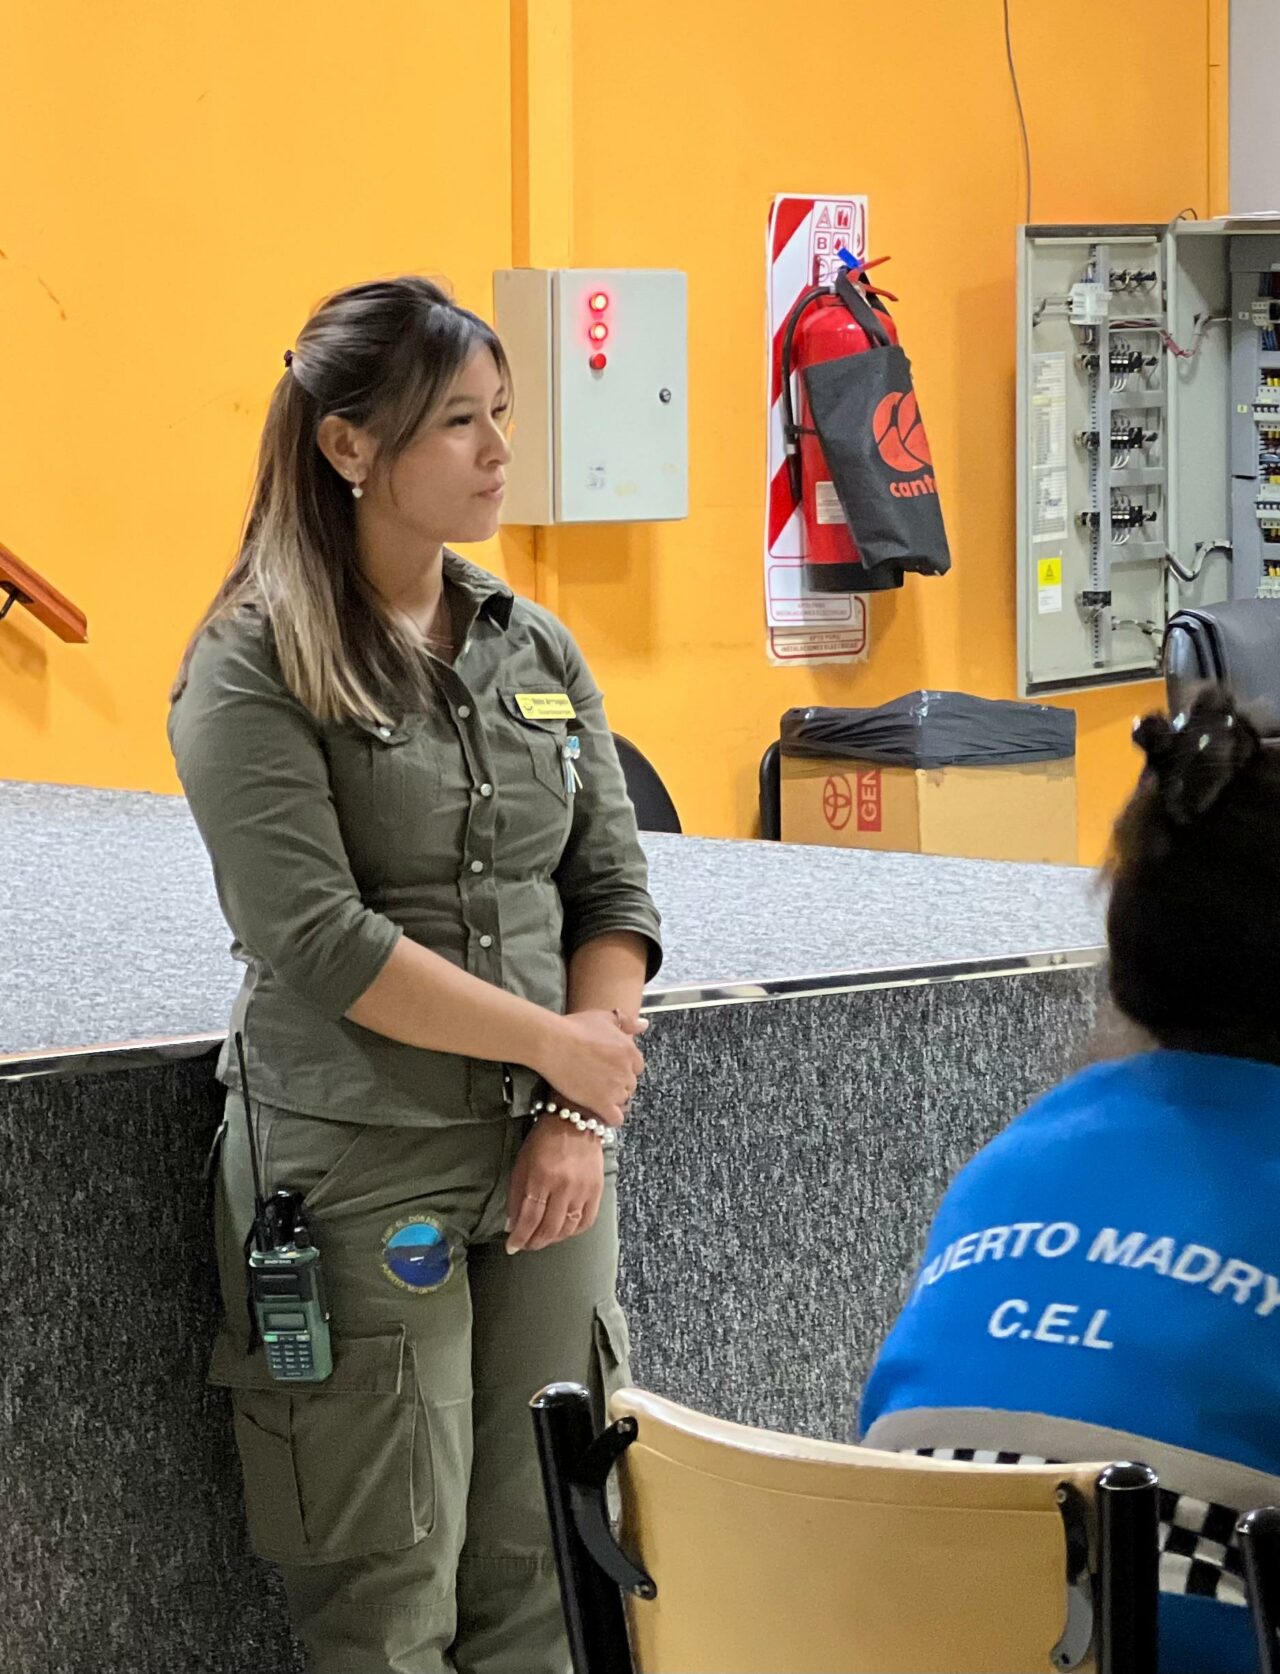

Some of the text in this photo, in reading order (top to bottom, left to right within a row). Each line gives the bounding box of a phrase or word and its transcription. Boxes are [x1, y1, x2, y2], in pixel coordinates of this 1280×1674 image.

[817, 237, 828, 250] B
[889, 474, 937, 498] cant
[988, 1299, 1115, 1350] C.E.L
